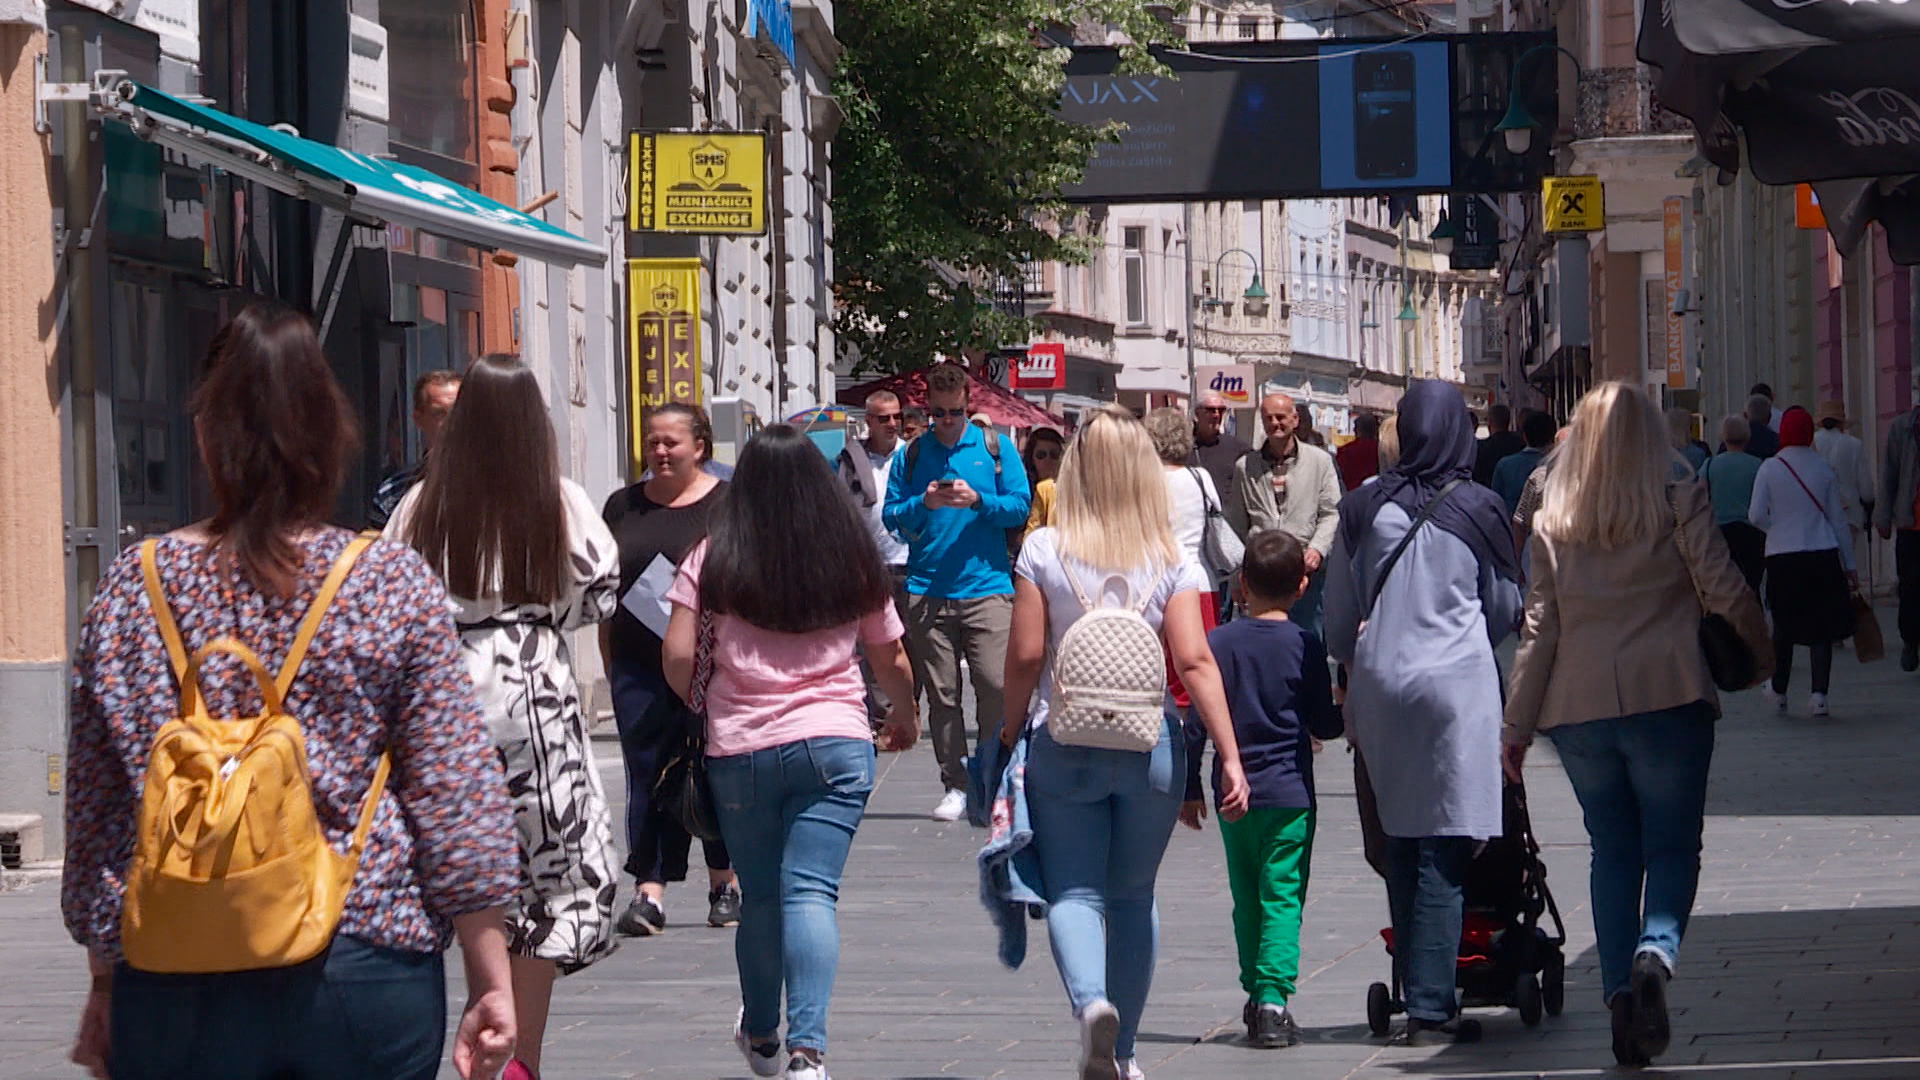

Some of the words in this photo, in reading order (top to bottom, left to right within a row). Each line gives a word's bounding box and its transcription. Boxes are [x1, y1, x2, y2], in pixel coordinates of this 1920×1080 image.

[1055, 79, 1159, 104] AJAX
[695, 153, 725, 166] SMS
[642, 137, 652, 228] EXCHANGE
[704, 167, 713, 178] A
[668, 213, 750, 226] EXCHANGE
[1667, 269, 1681, 373] BANKOMAT
[640, 323, 665, 406] MJENJ
[673, 323, 690, 398] EXC
[1210, 371, 1243, 391] dm
